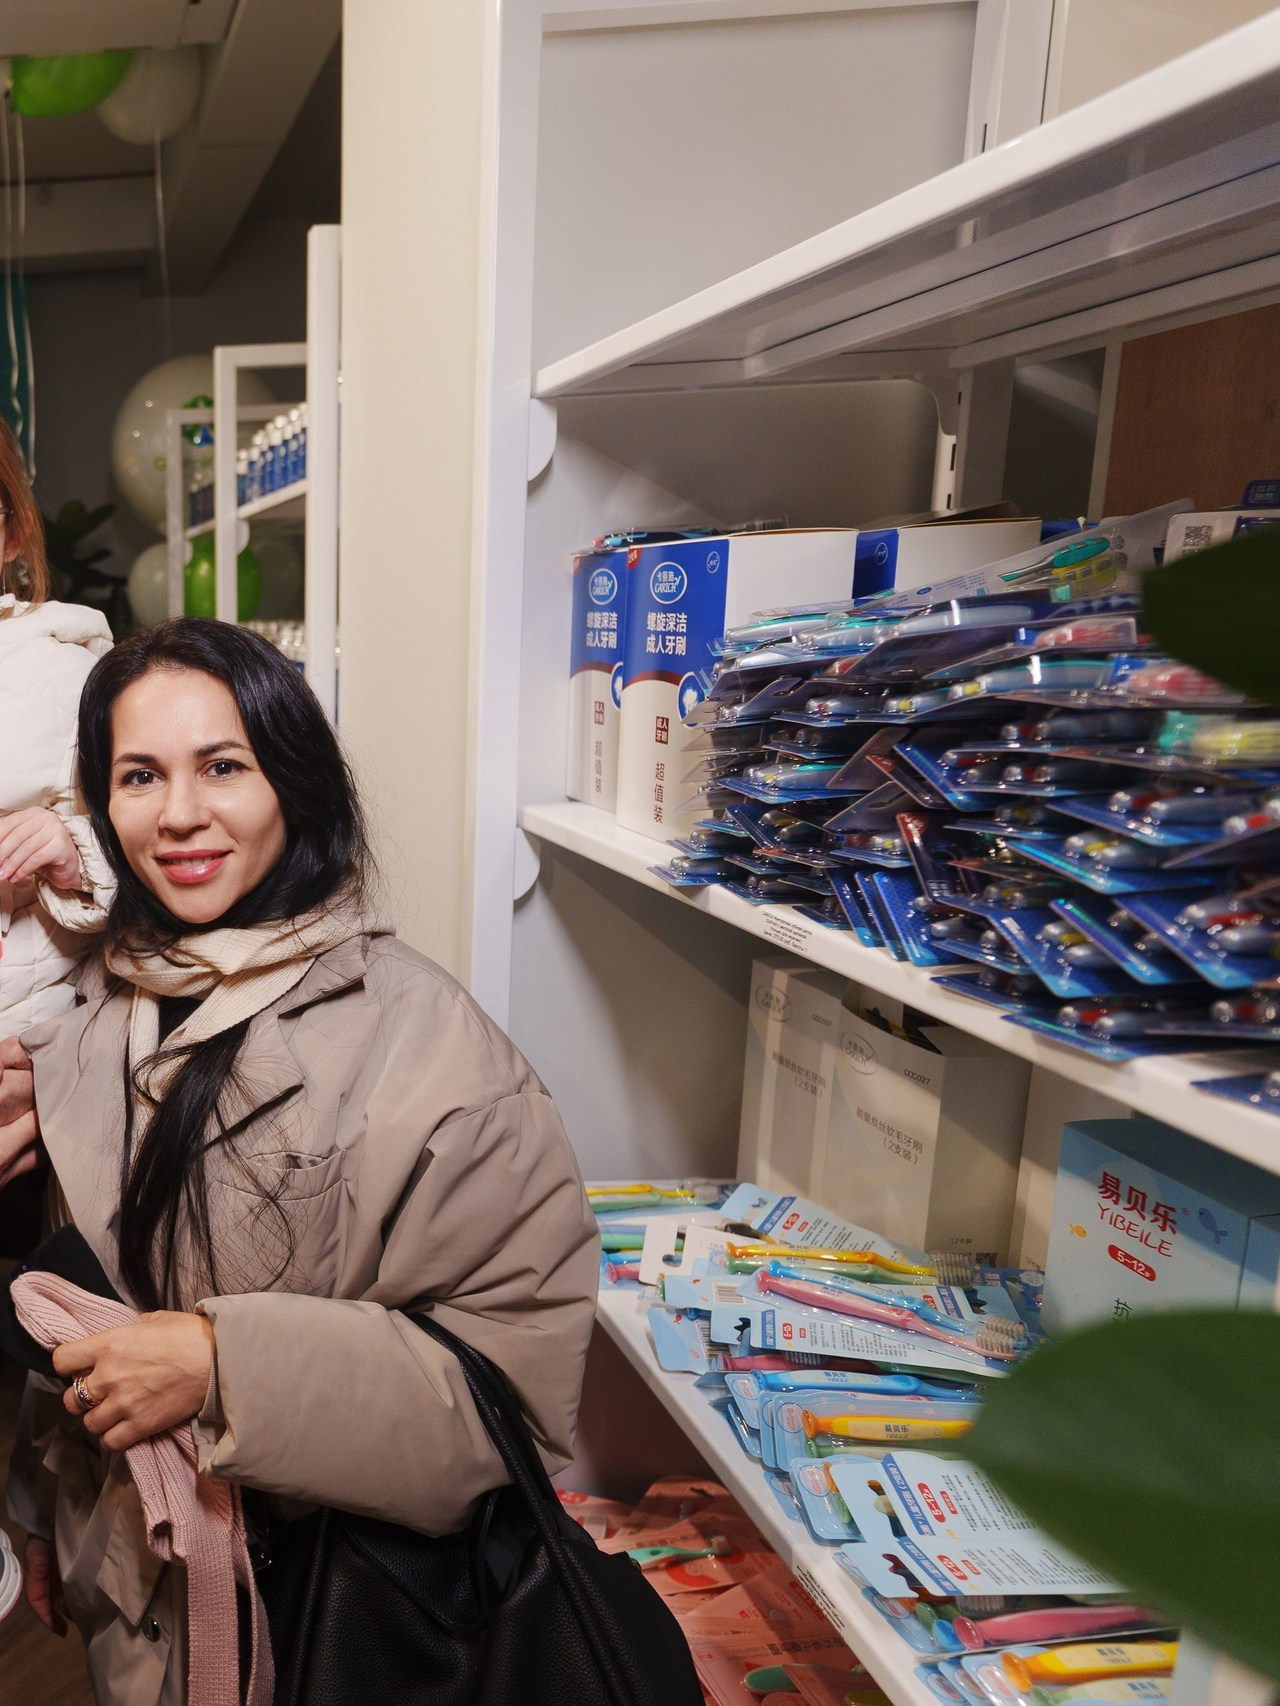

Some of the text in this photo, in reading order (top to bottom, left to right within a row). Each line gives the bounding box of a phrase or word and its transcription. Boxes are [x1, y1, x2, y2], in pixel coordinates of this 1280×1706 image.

[654, 581, 677, 593] CARICH
[586, 611, 618, 629] 螺旋深洁
[647, 612, 687, 633] 螺旋深洁
[586, 630, 617, 649] 成人牙刷
[646, 635, 687, 656] 成人牙刷
[657, 717, 668, 730] 成人
[655, 762, 665, 824] 超值装
[856, 1106, 923, 1154] 能量炭丝软毛牙刷
[1097, 1170, 1178, 1235] 易贝乐
[1097, 1201, 1173, 1258] YIBEILE
[885, 1423, 910, 1433] 易贝乐
